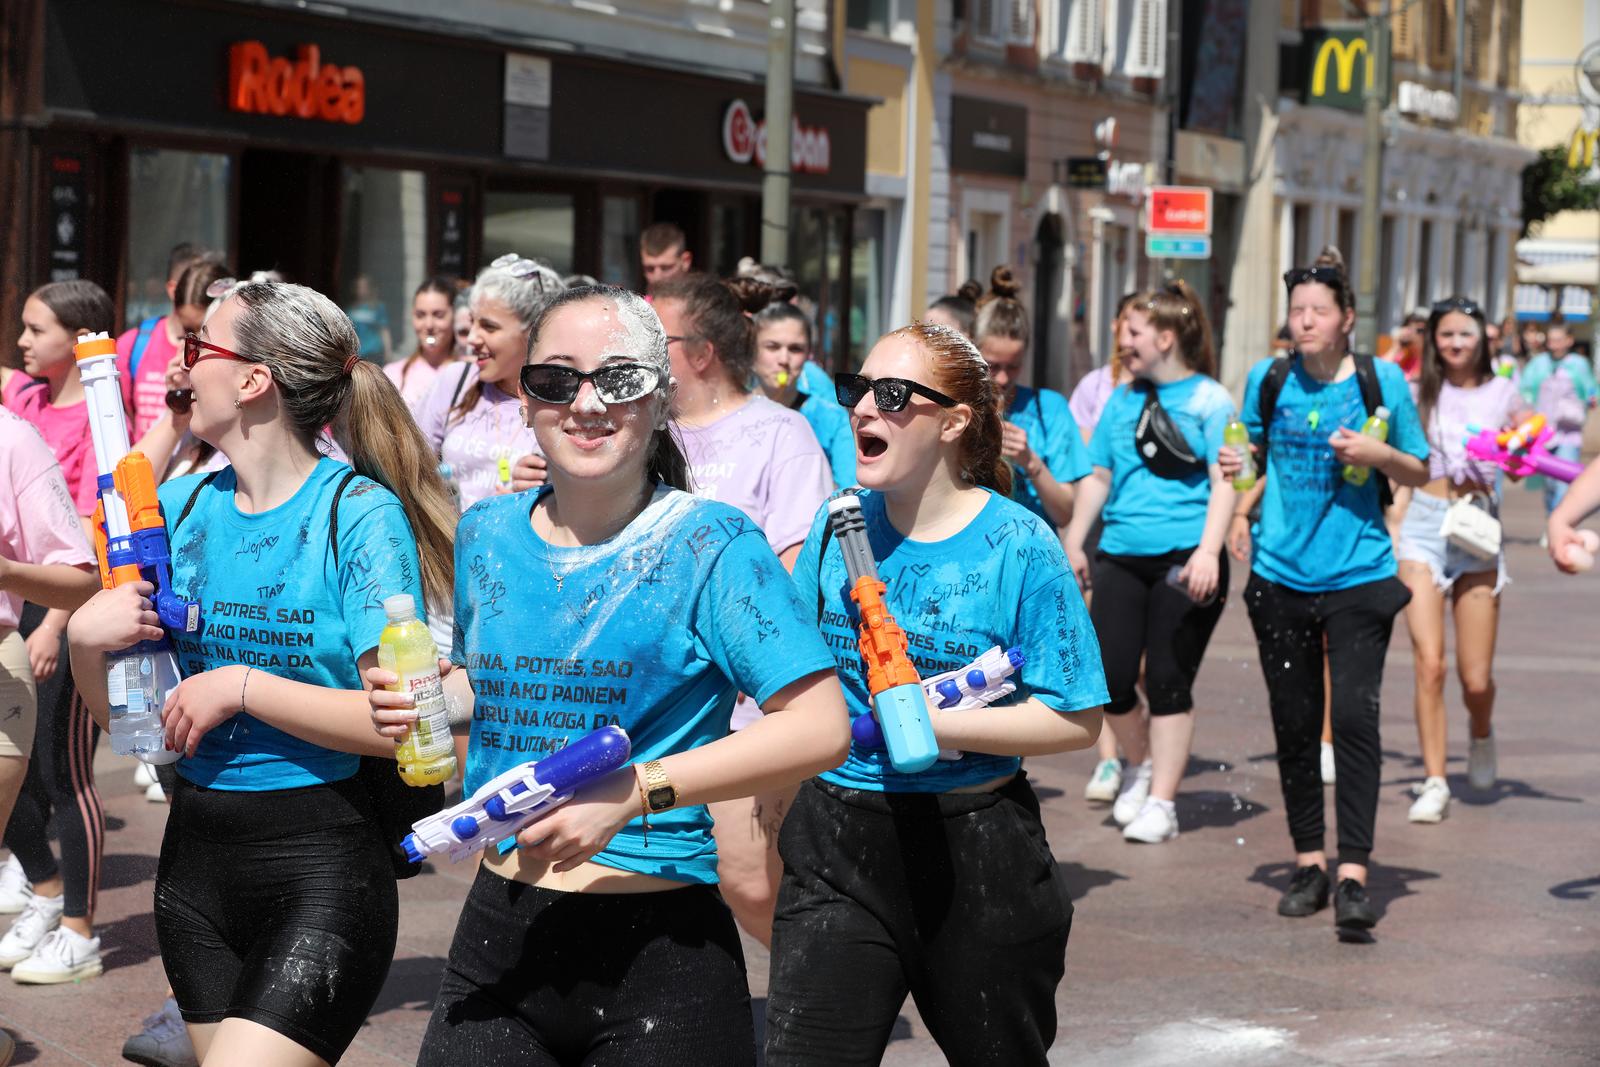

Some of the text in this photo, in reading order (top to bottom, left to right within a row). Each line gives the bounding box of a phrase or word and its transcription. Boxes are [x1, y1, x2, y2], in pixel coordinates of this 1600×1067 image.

[229, 39, 365, 125] Rodea
[212, 601, 271, 623] POTRES,
[276, 608, 316, 625] SAD
[205, 623, 314, 647] AKO PADNEM
[822, 610, 979, 658] ORON RES, SAD
[215, 646, 236, 662] NA
[238, 650, 282, 668] KOGA
[287, 654, 314, 668] DA
[468, 652, 634, 679] ONA, POTRES, SAD
[470, 679, 628, 704] TIN! AKO PADNEM
[472, 705, 621, 730] URU, NA KOGA DA
[480, 730, 500, 749] SE
